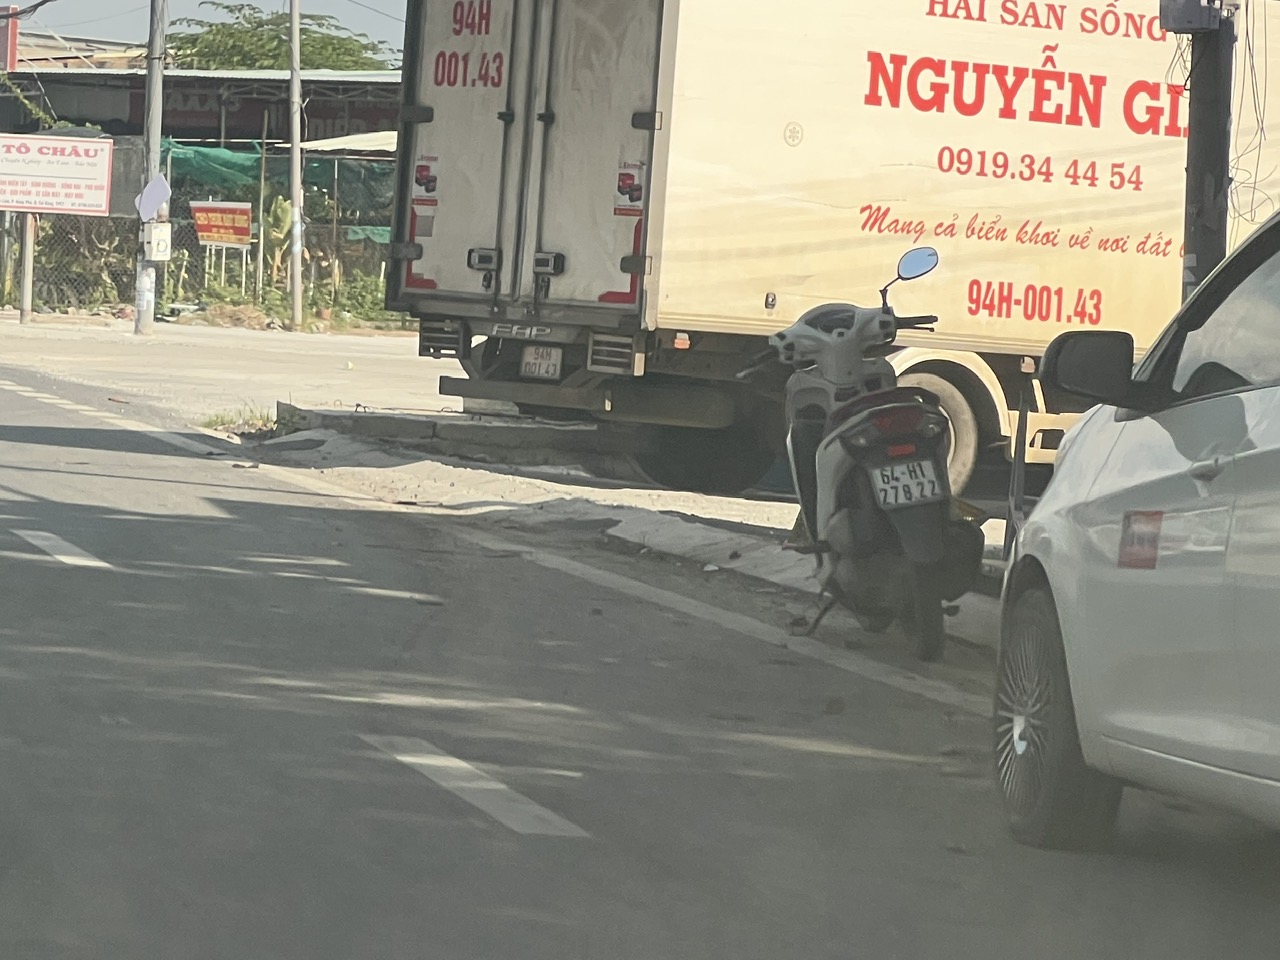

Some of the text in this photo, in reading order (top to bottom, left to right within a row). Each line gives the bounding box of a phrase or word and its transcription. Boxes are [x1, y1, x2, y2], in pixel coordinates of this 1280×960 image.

[452, 0, 492, 36] 94H
[433, 50, 504, 88] 001.43
[864, 43, 1189, 138] NGUYỄN GI
[1, 142, 99, 159] TÔ CHÂU
[937, 146, 1144, 191] 0919.34 44 54
[859, 204, 927, 244] Mang
[933, 213, 959, 239] cả
[965, 213, 1009, 242] biển
[1016, 219, 1061, 248] khơi
[1068, 226, 1094, 250] về
[1098, 236, 1129, 254] nơi
[1135, 231, 1177, 258] đất
[967, 278, 1103, 326] 94H-001.43
